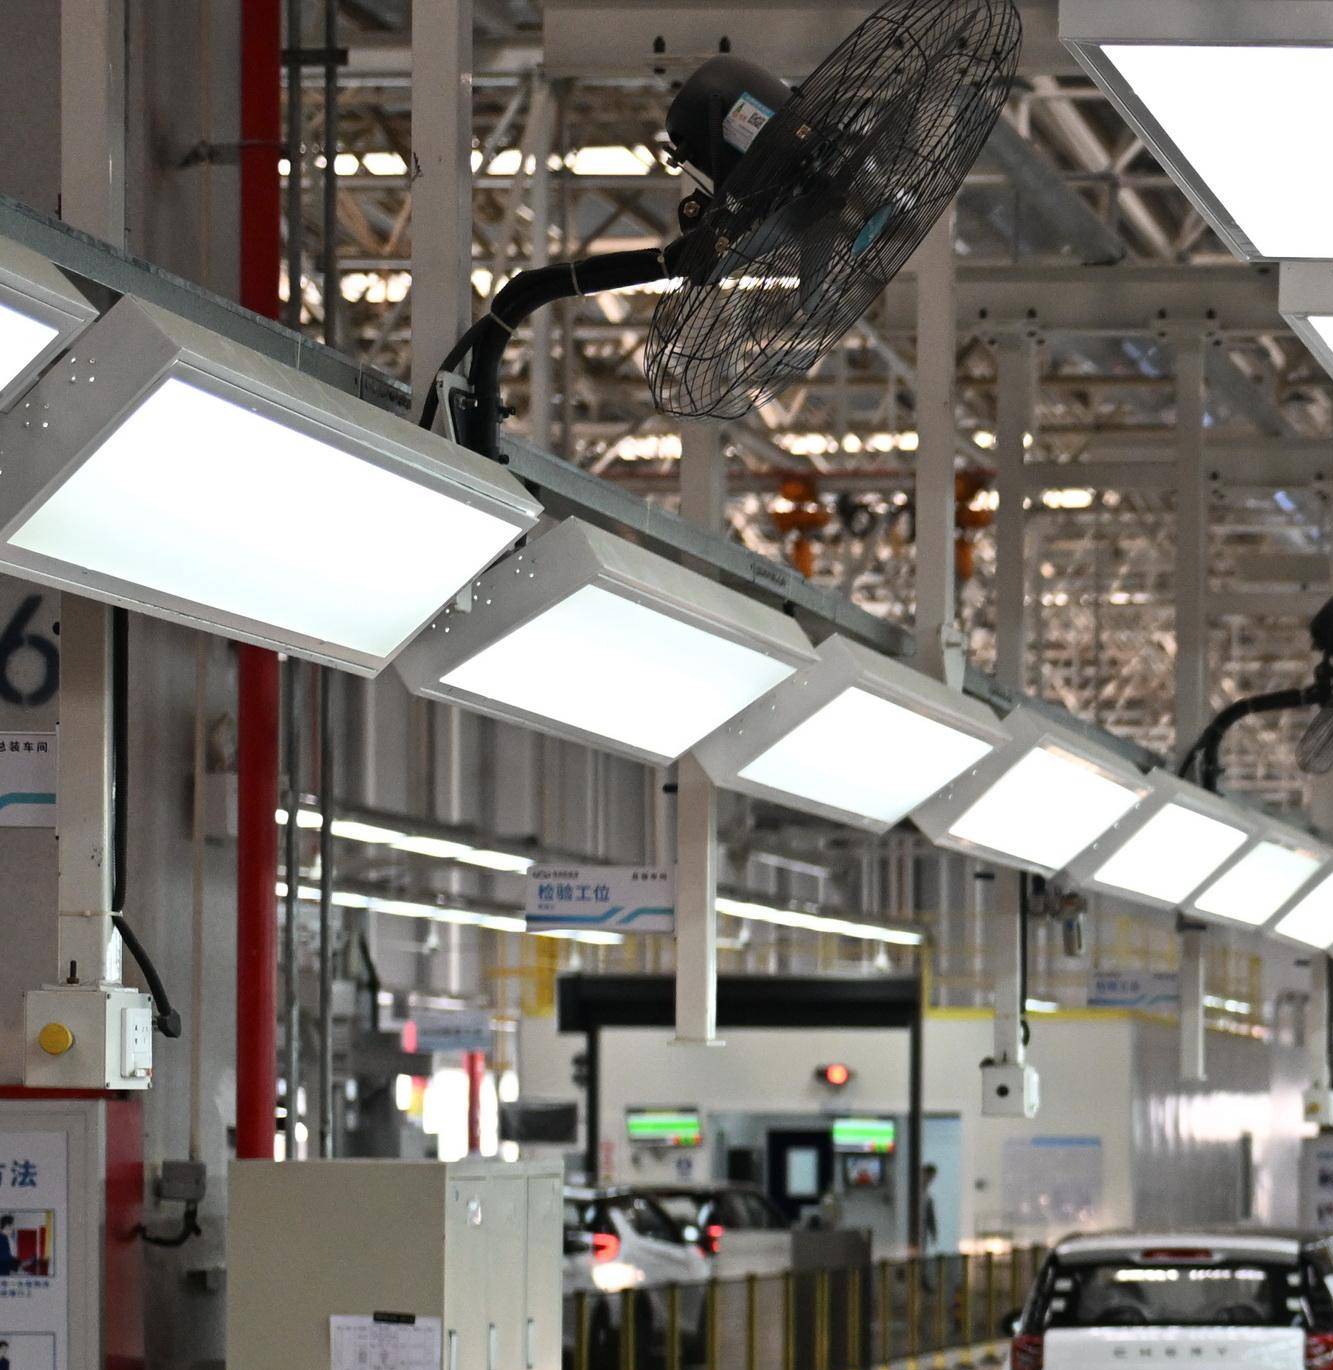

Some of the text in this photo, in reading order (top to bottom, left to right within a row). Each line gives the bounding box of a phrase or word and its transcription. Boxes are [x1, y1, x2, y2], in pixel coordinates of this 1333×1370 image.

[537, 883, 611, 903] 检验工位
[0, 1160, 37, 1188] 法
